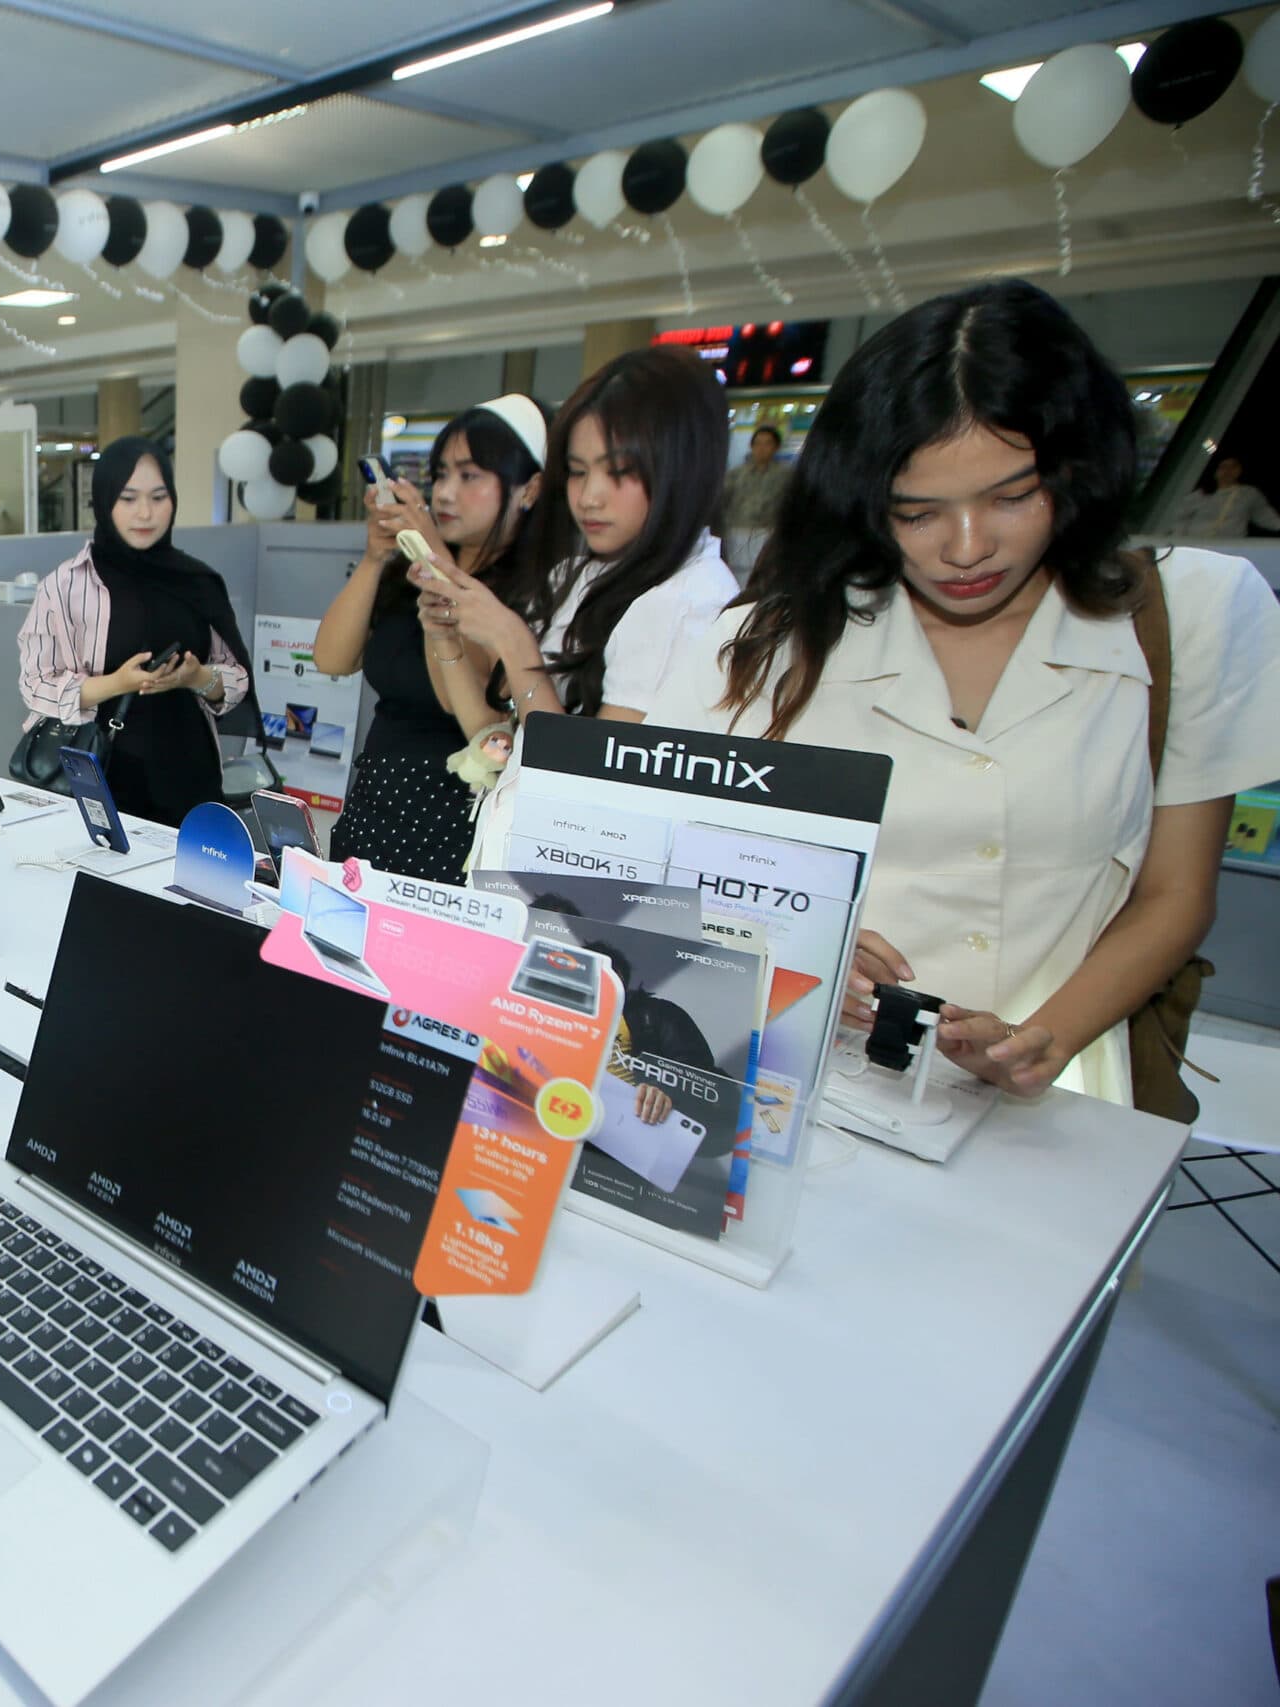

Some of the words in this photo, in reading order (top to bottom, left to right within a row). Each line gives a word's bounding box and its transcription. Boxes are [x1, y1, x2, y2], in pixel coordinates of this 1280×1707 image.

[603, 736, 776, 794] Infinix
[553, 819, 586, 833] Infinix
[600, 830, 620, 840] AMD
[201, 844, 227, 861] Infinix
[536, 845, 611, 874] XBOOK
[617, 864, 638, 880] 15
[739, 853, 776, 866] Infinix
[485, 881, 520, 891] Infinix
[698, 873, 768, 902] HOT
[773, 887, 810, 912] 70
[388, 879, 462, 911] XBOOK
[467, 899, 503, 922] B14
[535, 920, 570, 934] Infinix
[701, 922, 753, 938] GRES.ID
[491, 997, 526, 1015] AMD
[591, 1027, 601, 1039] 7
[412, 1015, 480, 1047] AGRES.ID
[27, 1137, 49, 1162] AMD
[354, 1135, 373, 1151] AMD
[472, 1124, 498, 1142] 13+
[502, 1136, 548, 1164] hours
[90, 1171, 114, 1194] AMD
[340, 1181, 360, 1196] AMD
[156, 1211, 184, 1236] AMD
[236, 1259, 269, 1287] AMD
